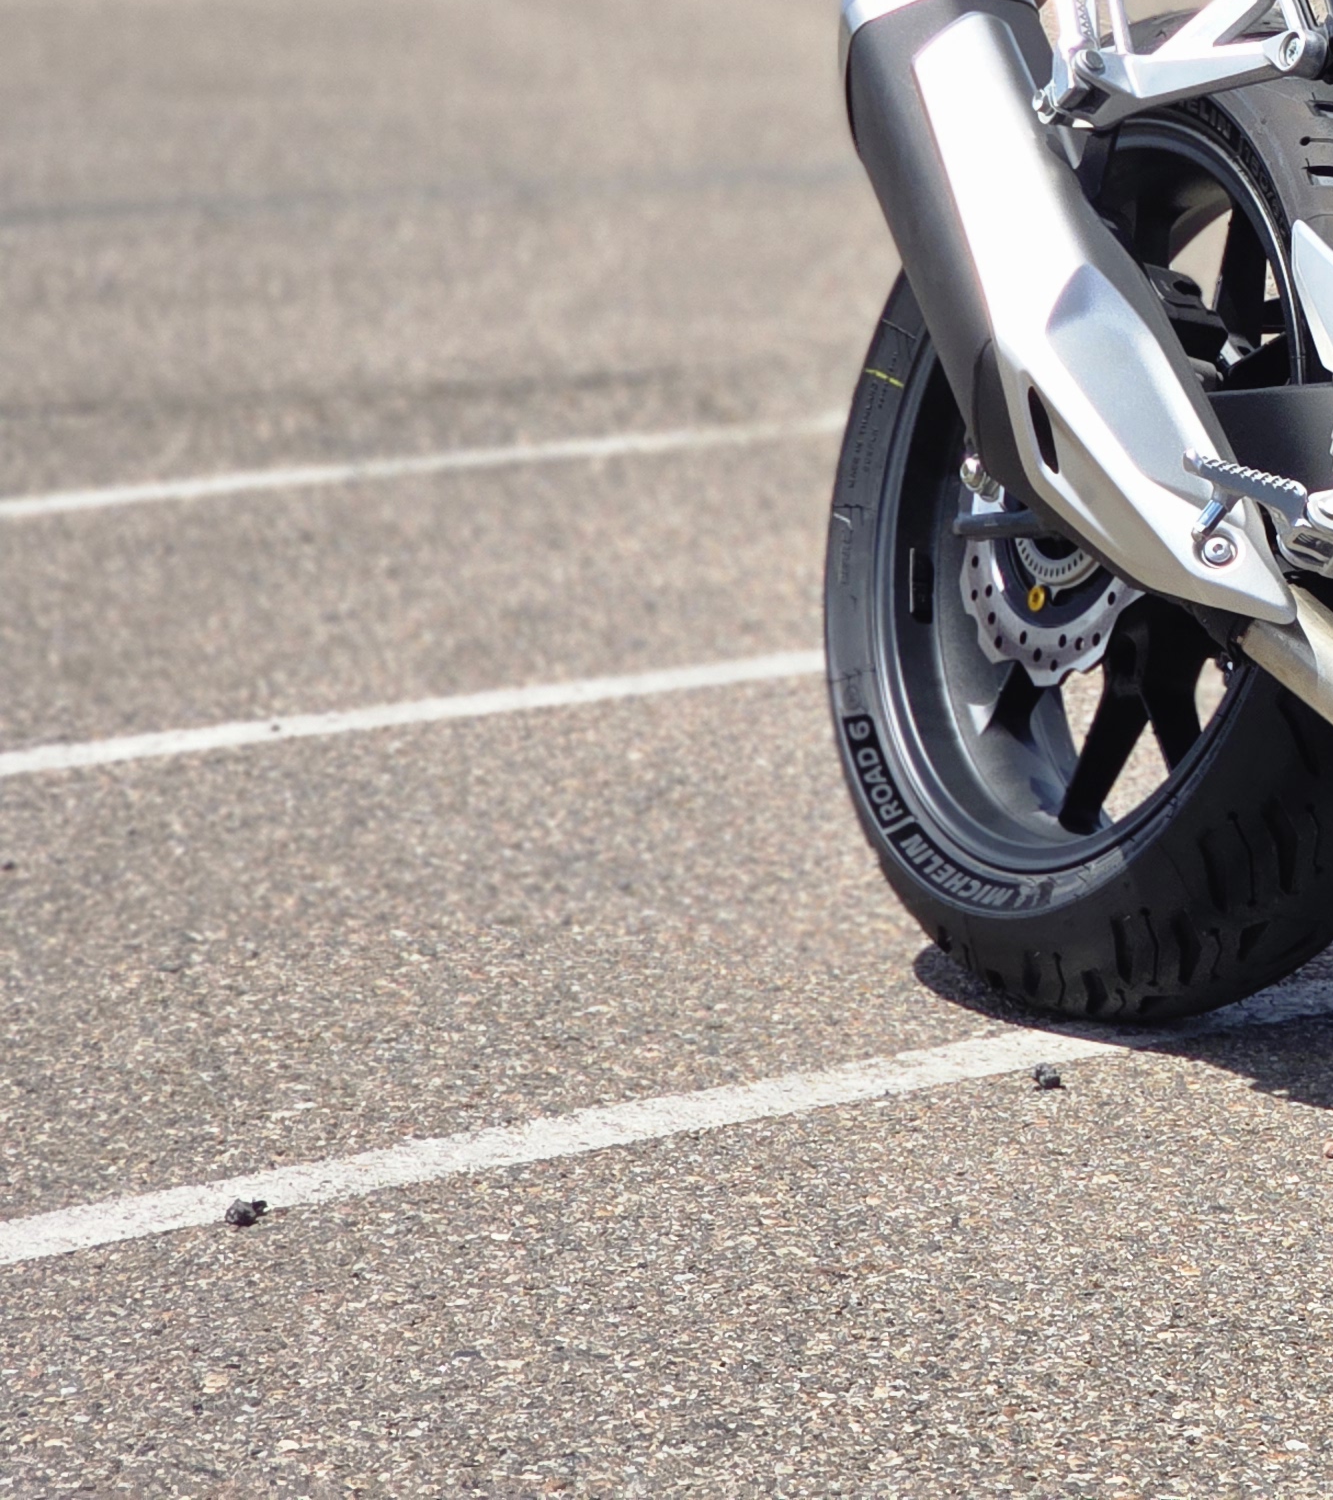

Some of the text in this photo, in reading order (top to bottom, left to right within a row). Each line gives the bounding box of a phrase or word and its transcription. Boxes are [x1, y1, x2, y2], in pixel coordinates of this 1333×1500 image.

[849, 721, 1014, 906] MICHELIN ROAD 6
